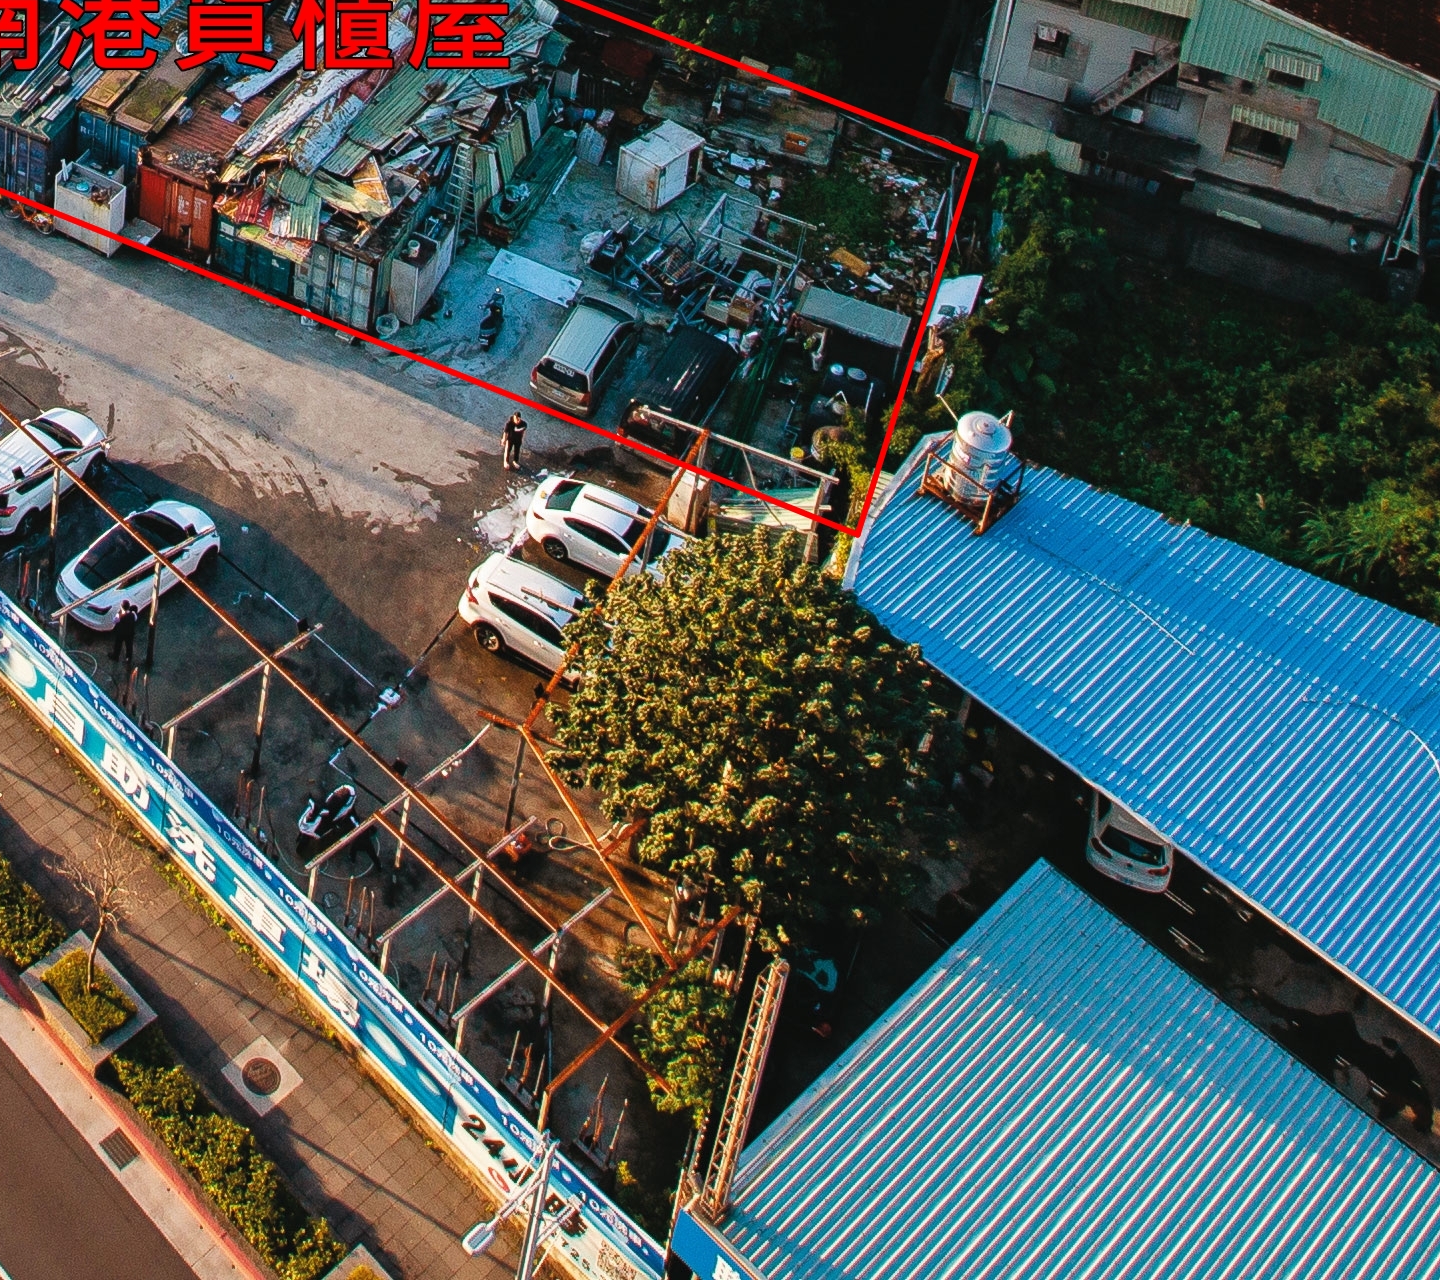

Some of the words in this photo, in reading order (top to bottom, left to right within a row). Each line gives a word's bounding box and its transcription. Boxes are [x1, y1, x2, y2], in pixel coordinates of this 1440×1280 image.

[44, 683, 361, 1028] 自助洗車場
